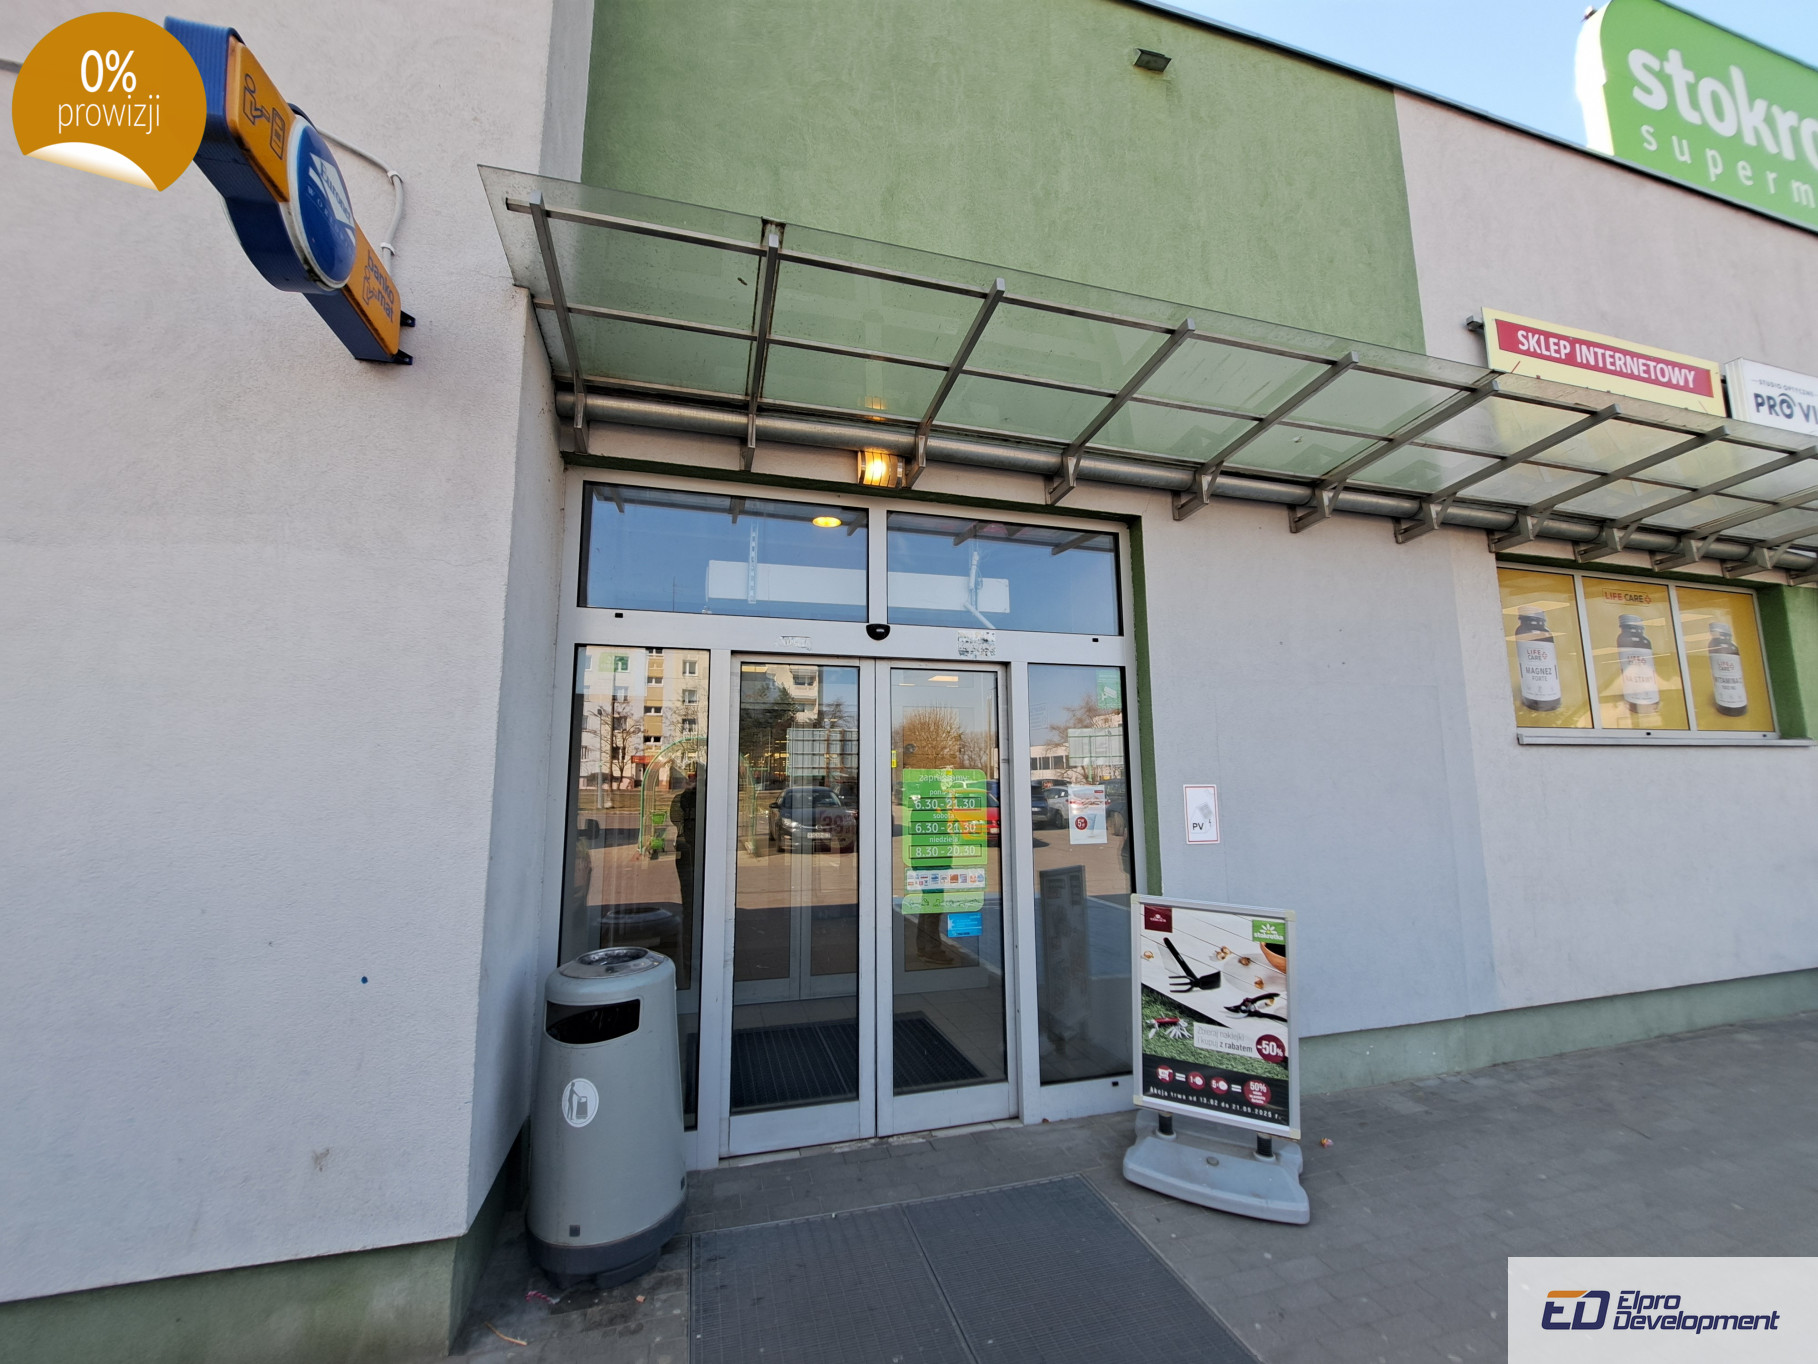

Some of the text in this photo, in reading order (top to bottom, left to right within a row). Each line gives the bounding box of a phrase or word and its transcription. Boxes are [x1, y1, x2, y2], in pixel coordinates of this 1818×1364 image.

[1642, 124, 1816, 209] superm
[367, 249, 395, 305] banko
[377, 289, 394, 323] mat
[1517, 329, 1697, 389] SKLEP INTERNETOWY
[1753, 392, 1795, 420] PRO
[1604, 591, 1644, 602] LIFE CARE
[1525, 666, 1552, 675] MAGNEZ
[915, 799, 938, 809] 6.30
[946, 799, 975, 809] 21.30
[915, 823, 939, 833] 6.30
[947, 823, 976, 833] 21.30
[1192, 822, 1204, 831] PV
[916, 846, 938, 857] 8.30
[947, 845, 976, 856] 20.30
[1225, 1042, 1253, 1053] rabatem
[1257, 1040, 1284, 1057] -50%
[1249, 1082, 1267, 1093] 50%
[1149, 1086, 1168, 1097] Akcja
[1170, 1091, 1187, 1100] trwa
[1221, 1101, 1230, 1109] do
